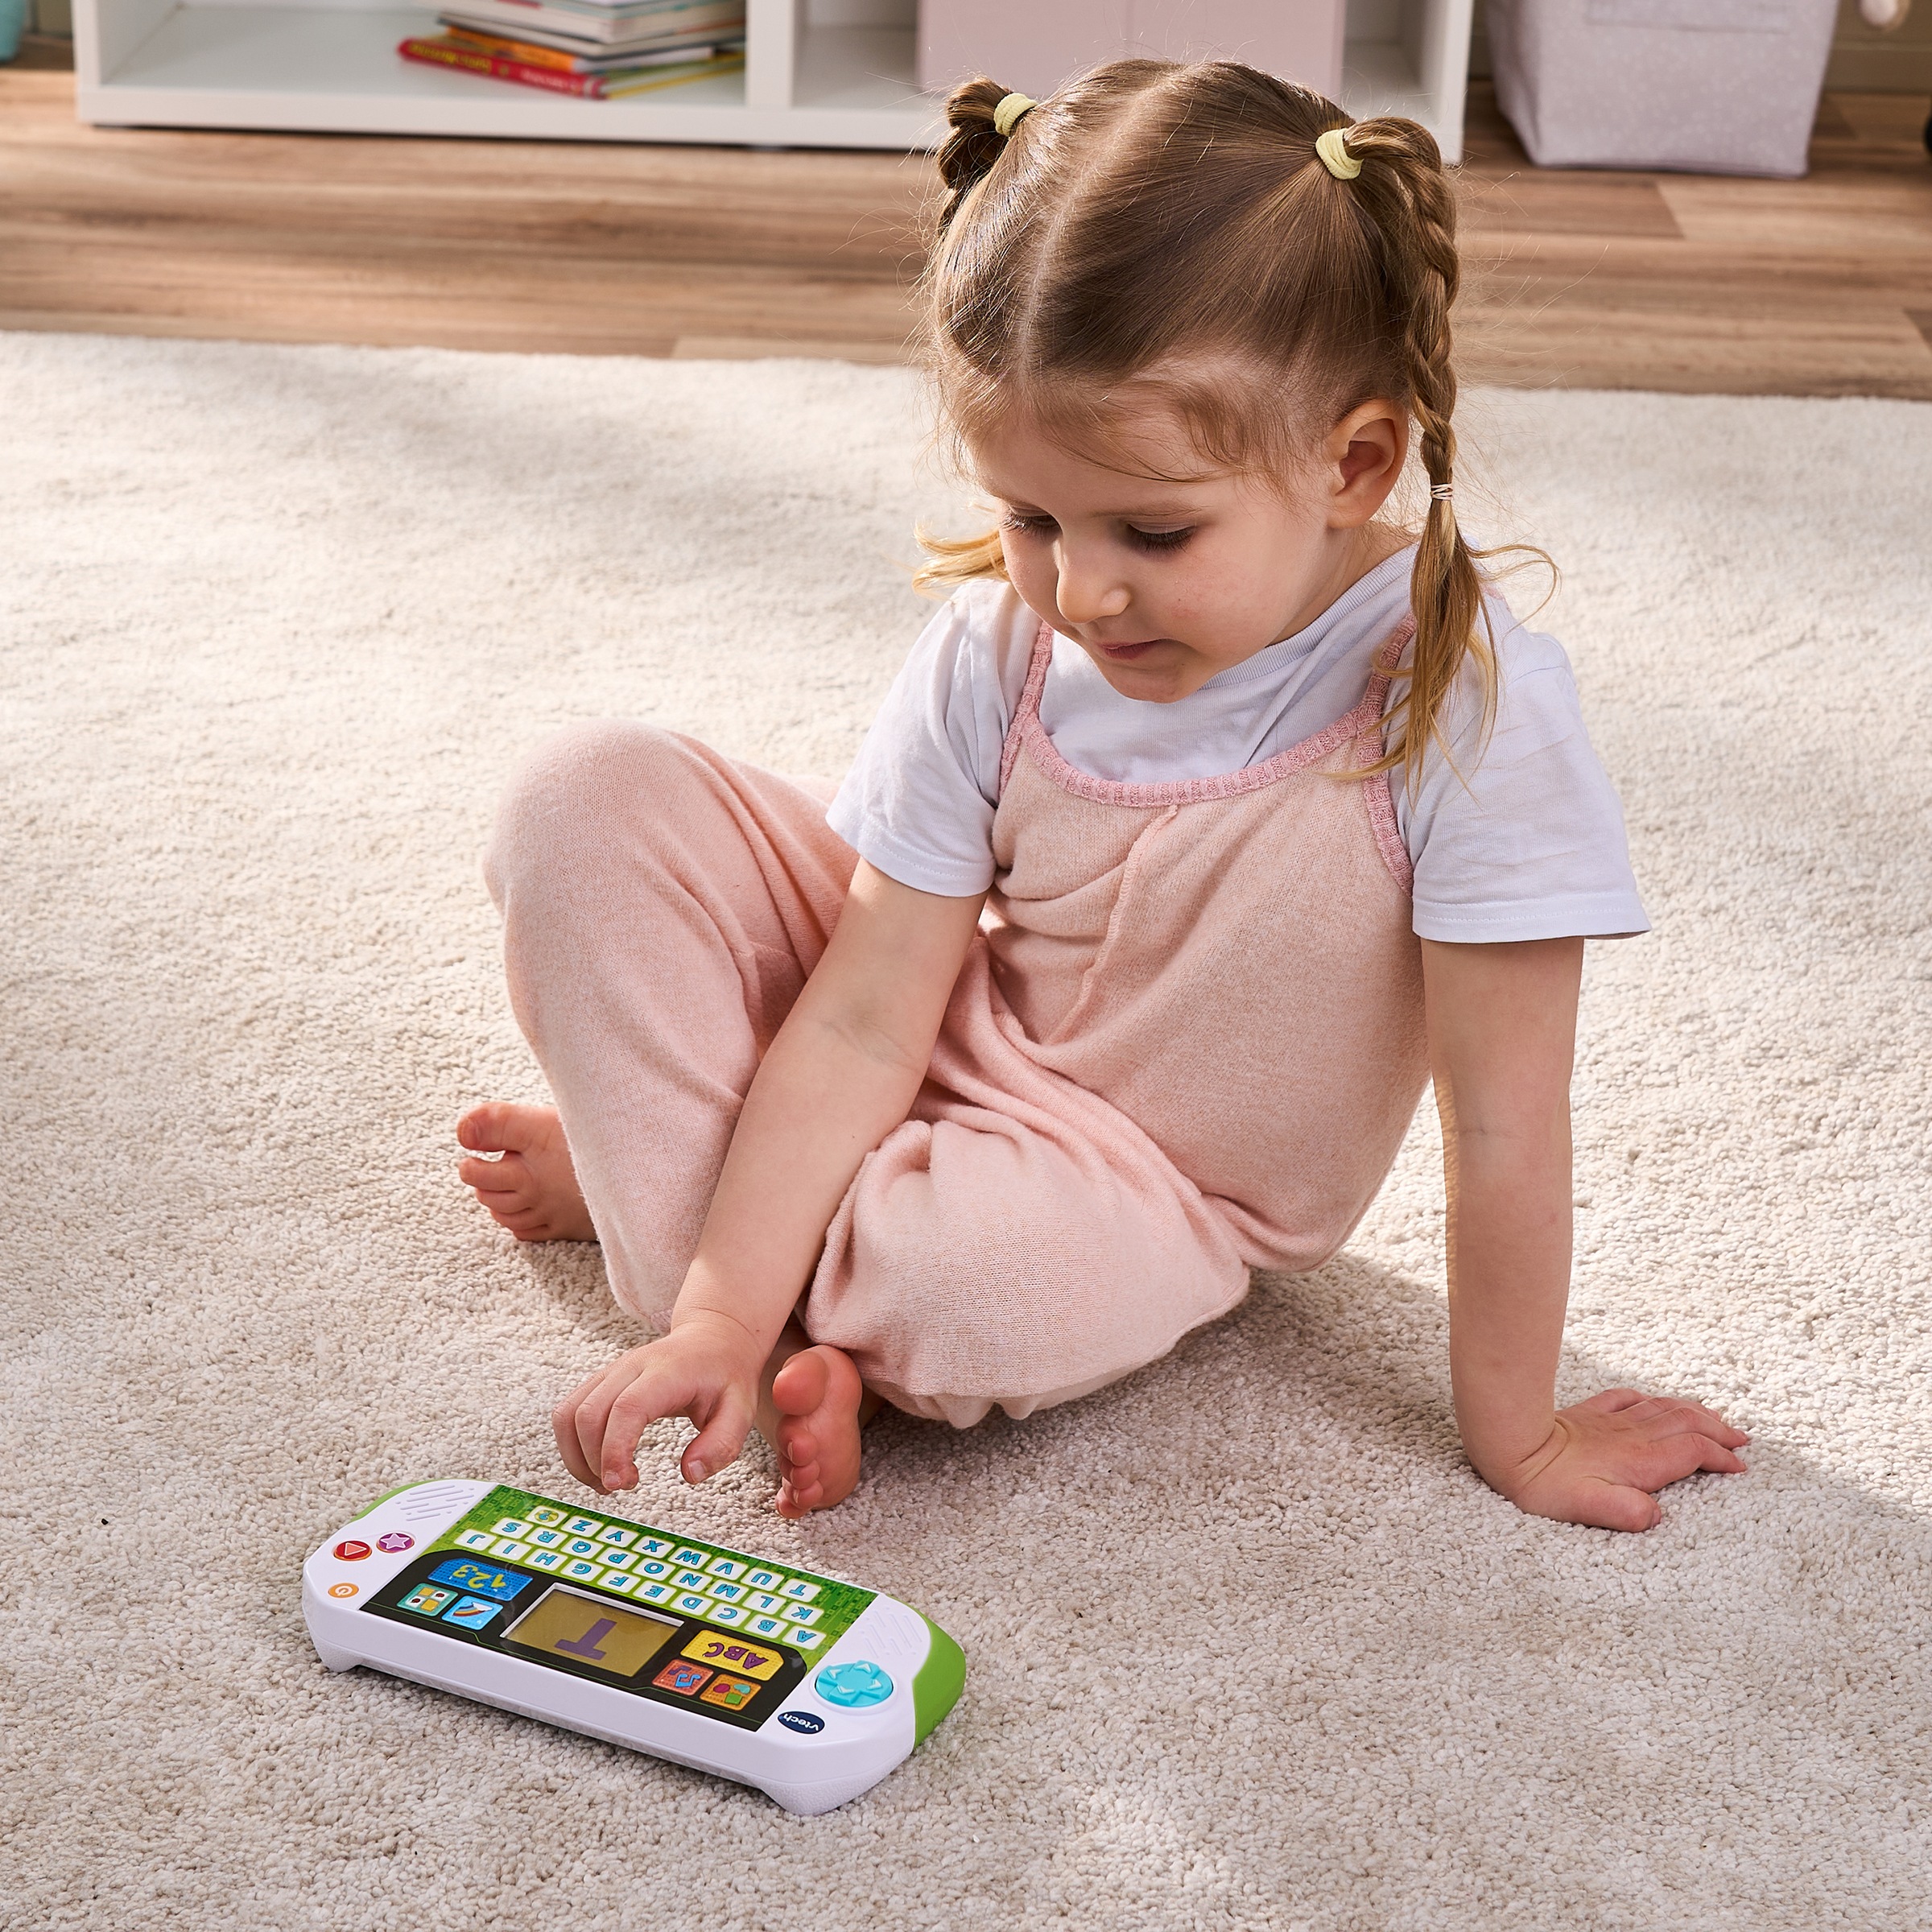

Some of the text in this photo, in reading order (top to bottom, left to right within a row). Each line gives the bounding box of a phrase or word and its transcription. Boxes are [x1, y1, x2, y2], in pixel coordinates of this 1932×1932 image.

[572, 1520, 592, 1531] Z
[605, 1530, 624, 1542] Y
[642, 1541, 664, 1552] X
[675, 1551, 701, 1565] W
[502, 1523, 813, 1620] K L M N O P Q R S
[715, 1562, 734, 1575] V
[452, 1564, 506, 1588] 123
[751, 1573, 772, 1585] U
[467, 1534, 816, 1642] A B C D E F G H I J
[788, 1583, 807, 1596] T
[554, 1617, 617, 1661] T
[703, 1641, 769, 1670] ABC
